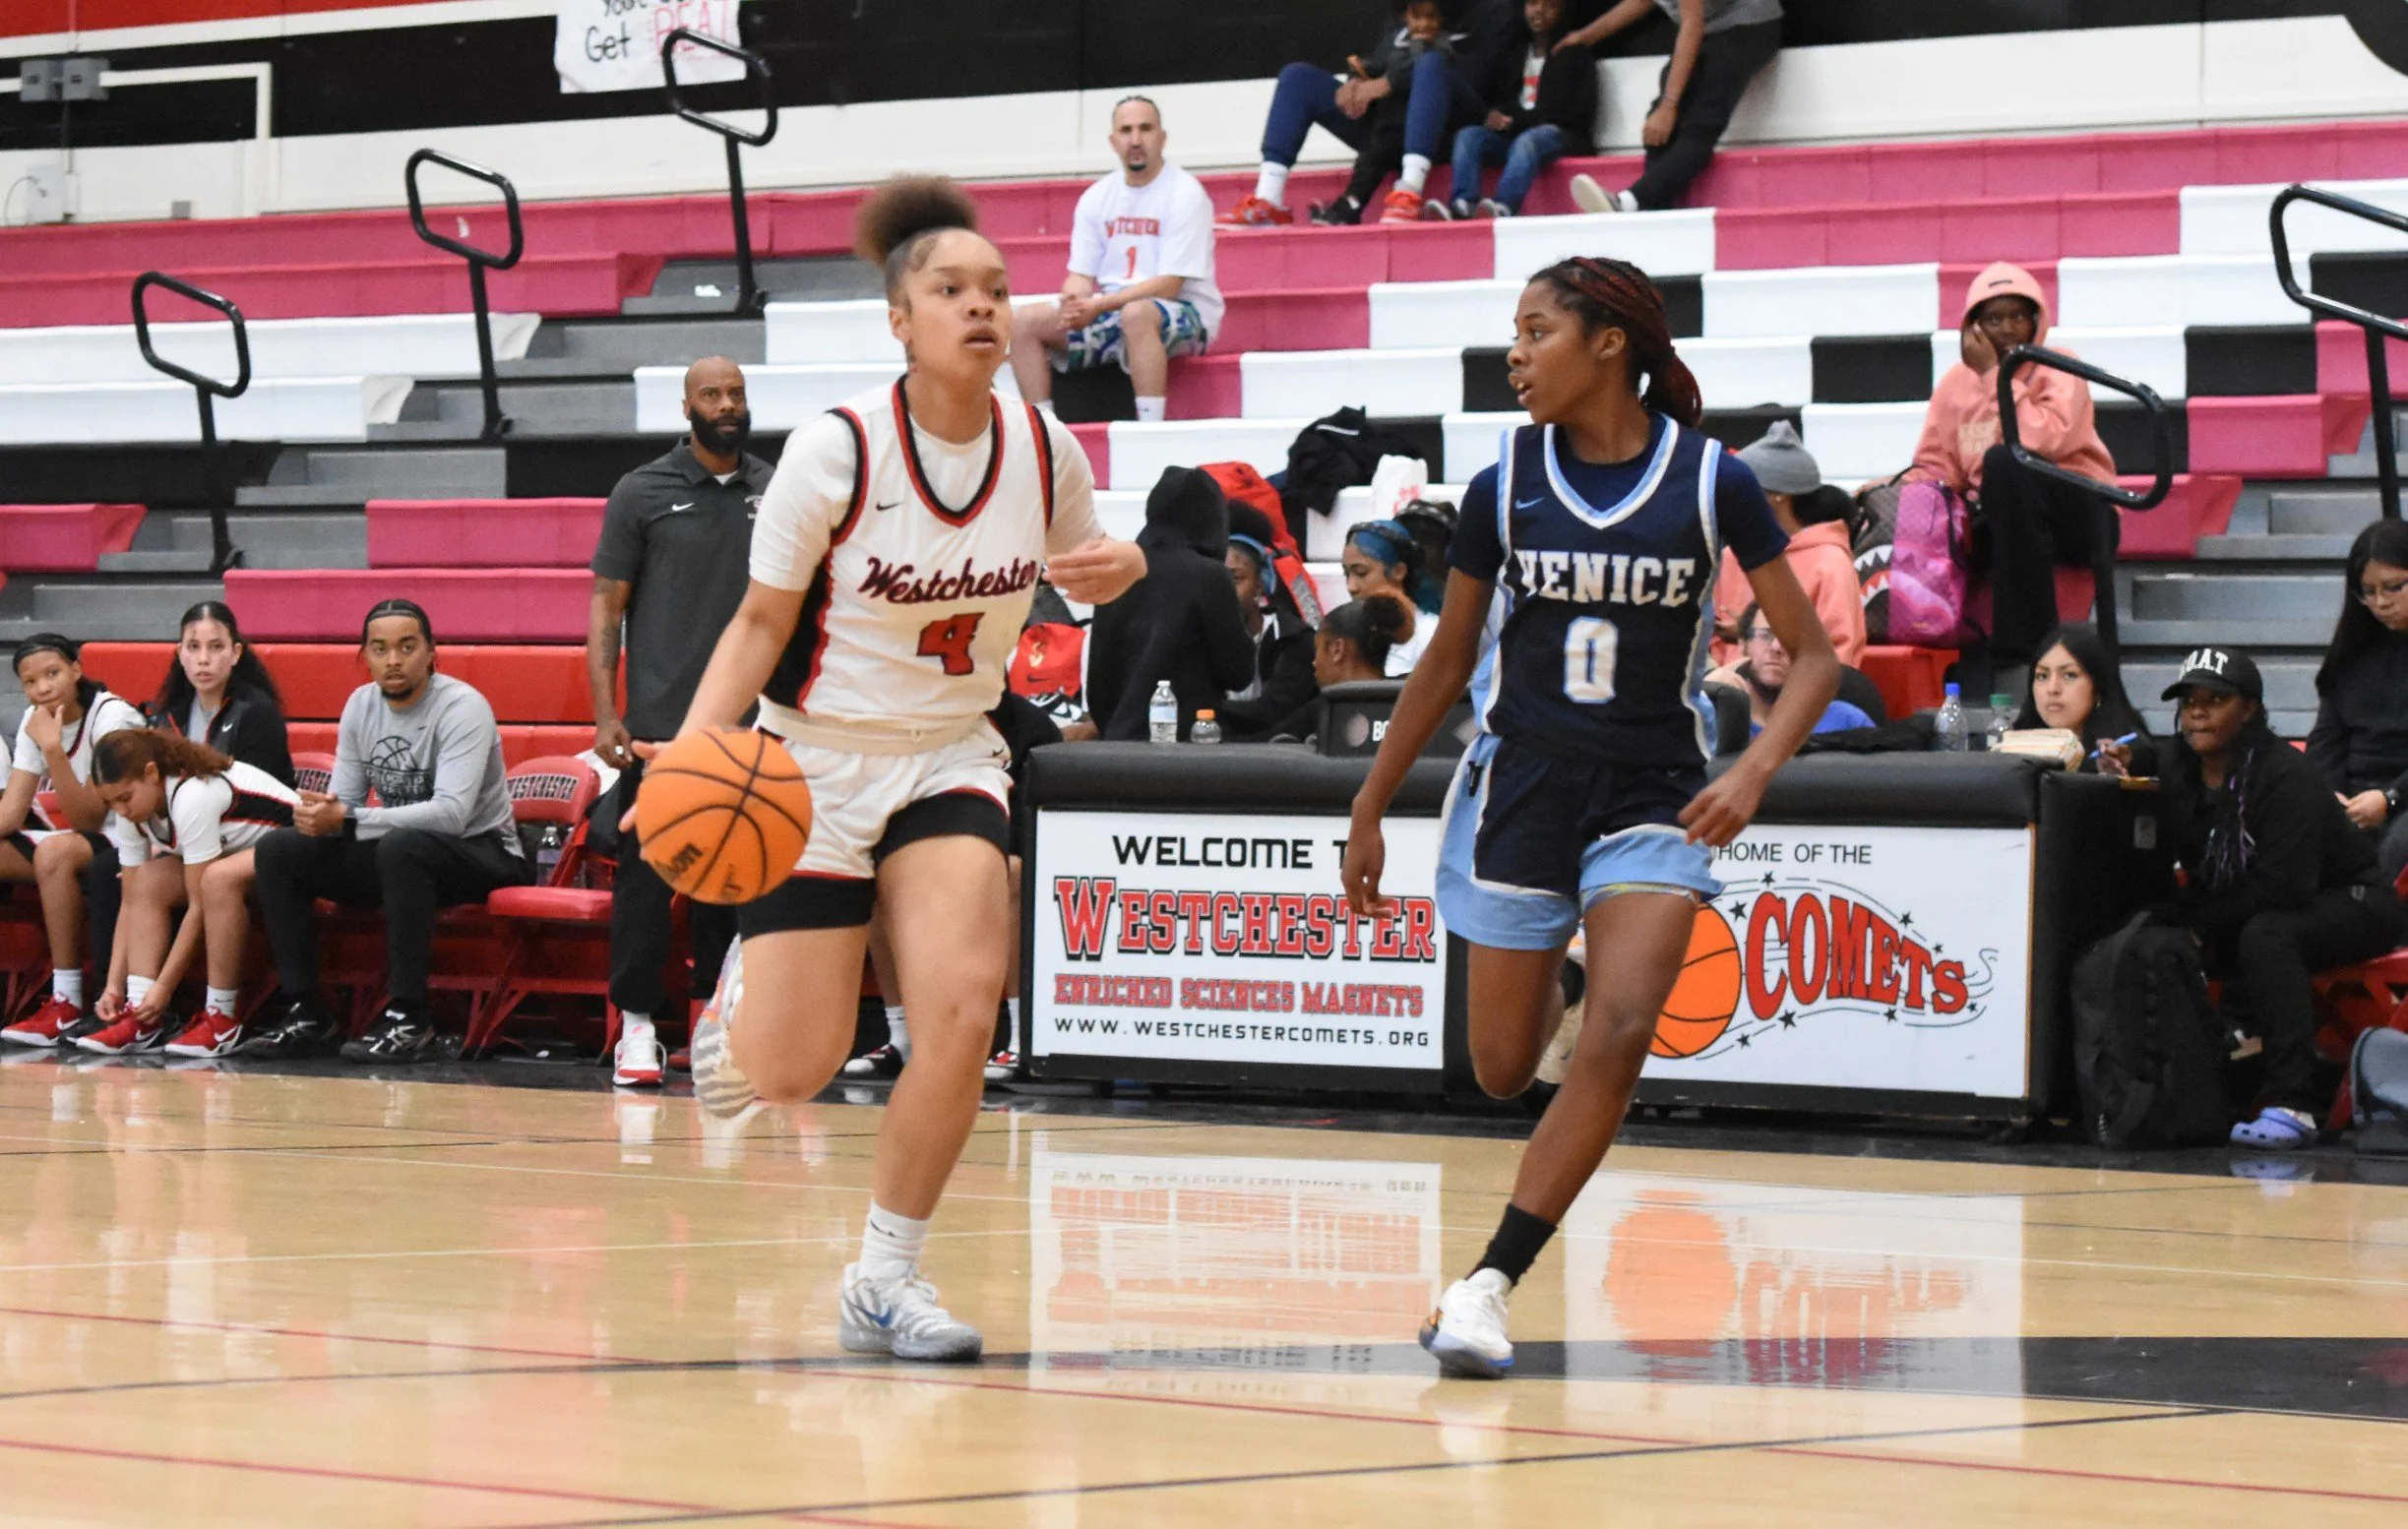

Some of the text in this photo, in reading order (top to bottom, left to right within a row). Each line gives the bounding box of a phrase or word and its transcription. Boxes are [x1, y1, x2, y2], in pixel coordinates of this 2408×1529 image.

[585, 22, 631, 62] Get
[1513, 549, 1696, 606] VENICE
[916, 611, 986, 676] 4
[1563, 615, 1619, 703] 0
[1112, 835, 1349, 870] WELCOME T
[1718, 841, 1873, 864] HOME OF THE
[1053, 876, 1437, 963] WESTCHESTER
[1745, 890, 1969, 1021] COMETS
[1053, 973, 1424, 1017] ENRICHED SCIENCES MAGNETS
[1054, 1017, 1429, 1047] WWW.WESTCHESTERCOMETS.ORG
